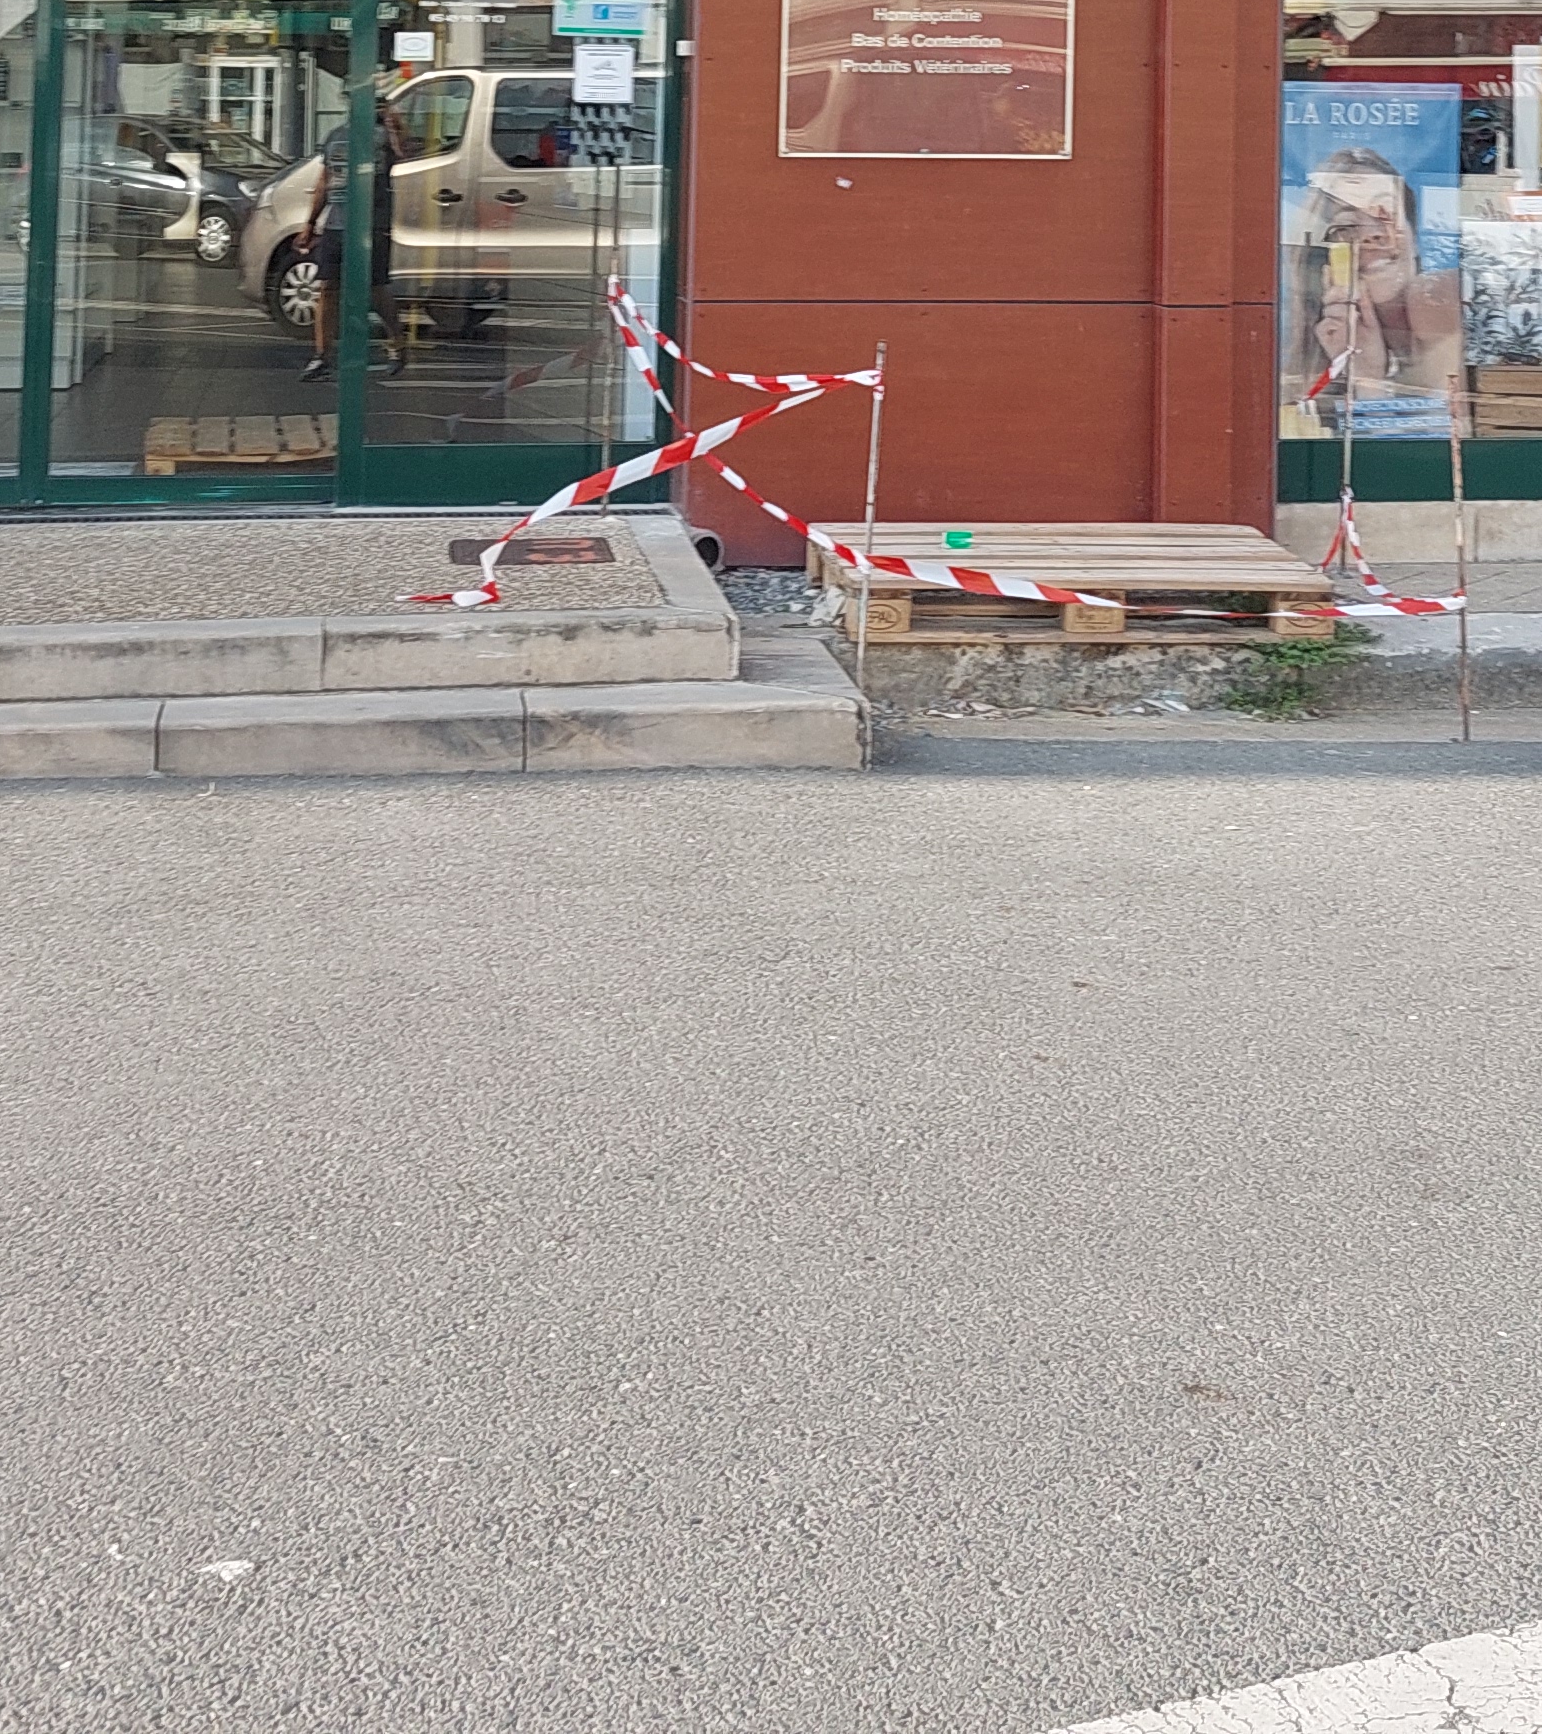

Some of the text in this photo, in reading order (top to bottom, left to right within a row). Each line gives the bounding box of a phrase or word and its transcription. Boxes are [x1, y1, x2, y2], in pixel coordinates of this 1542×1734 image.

[872, 7, 983, 24] Homéopathie
[851, 33, 1004, 49] Bas de Contention
[840, 59, 1014, 74] Produits Vétérinaires
[1284, 98, 1421, 126] LA ROSÉE
